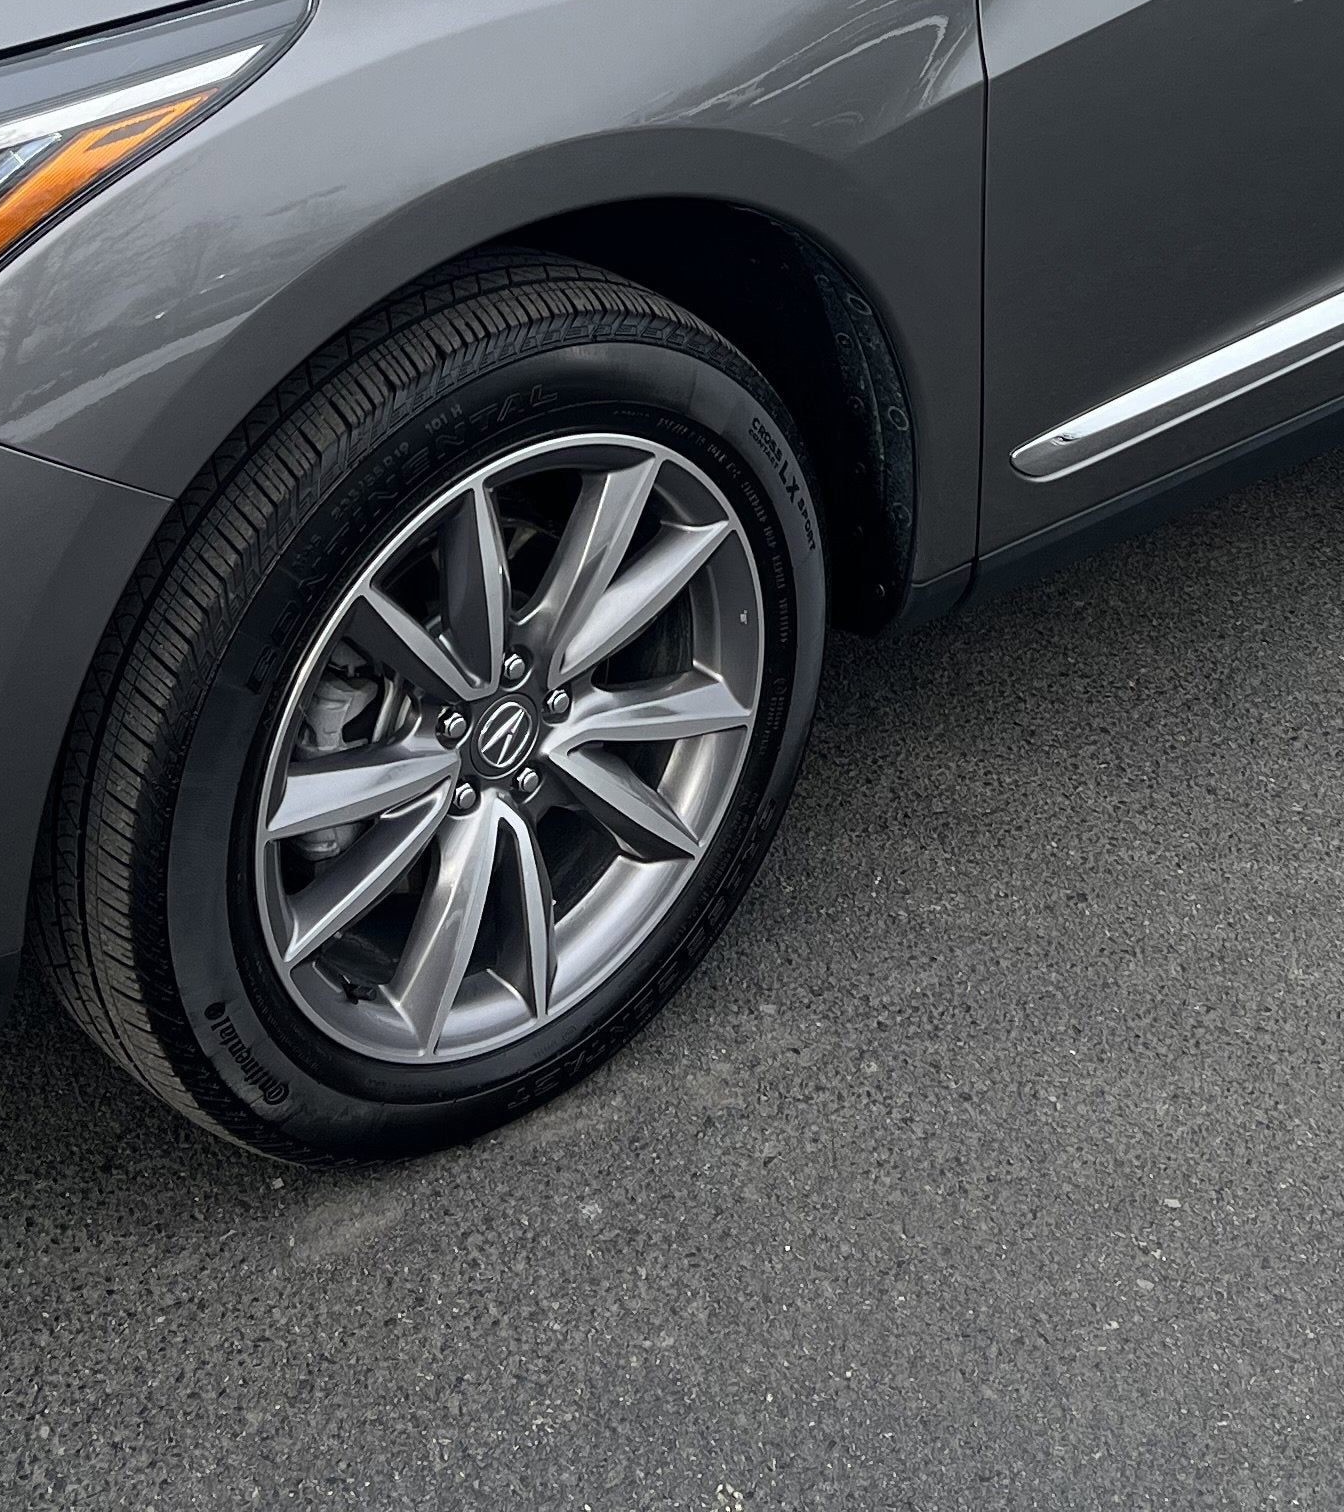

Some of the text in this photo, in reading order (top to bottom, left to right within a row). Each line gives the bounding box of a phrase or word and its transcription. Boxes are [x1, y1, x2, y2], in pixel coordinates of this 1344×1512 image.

[747, 427, 780, 470] CONTACT
[751, 416, 783, 463] CROSS
[778, 459, 816, 551] LX SPORT
[209, 1015, 290, 1106] Continental
